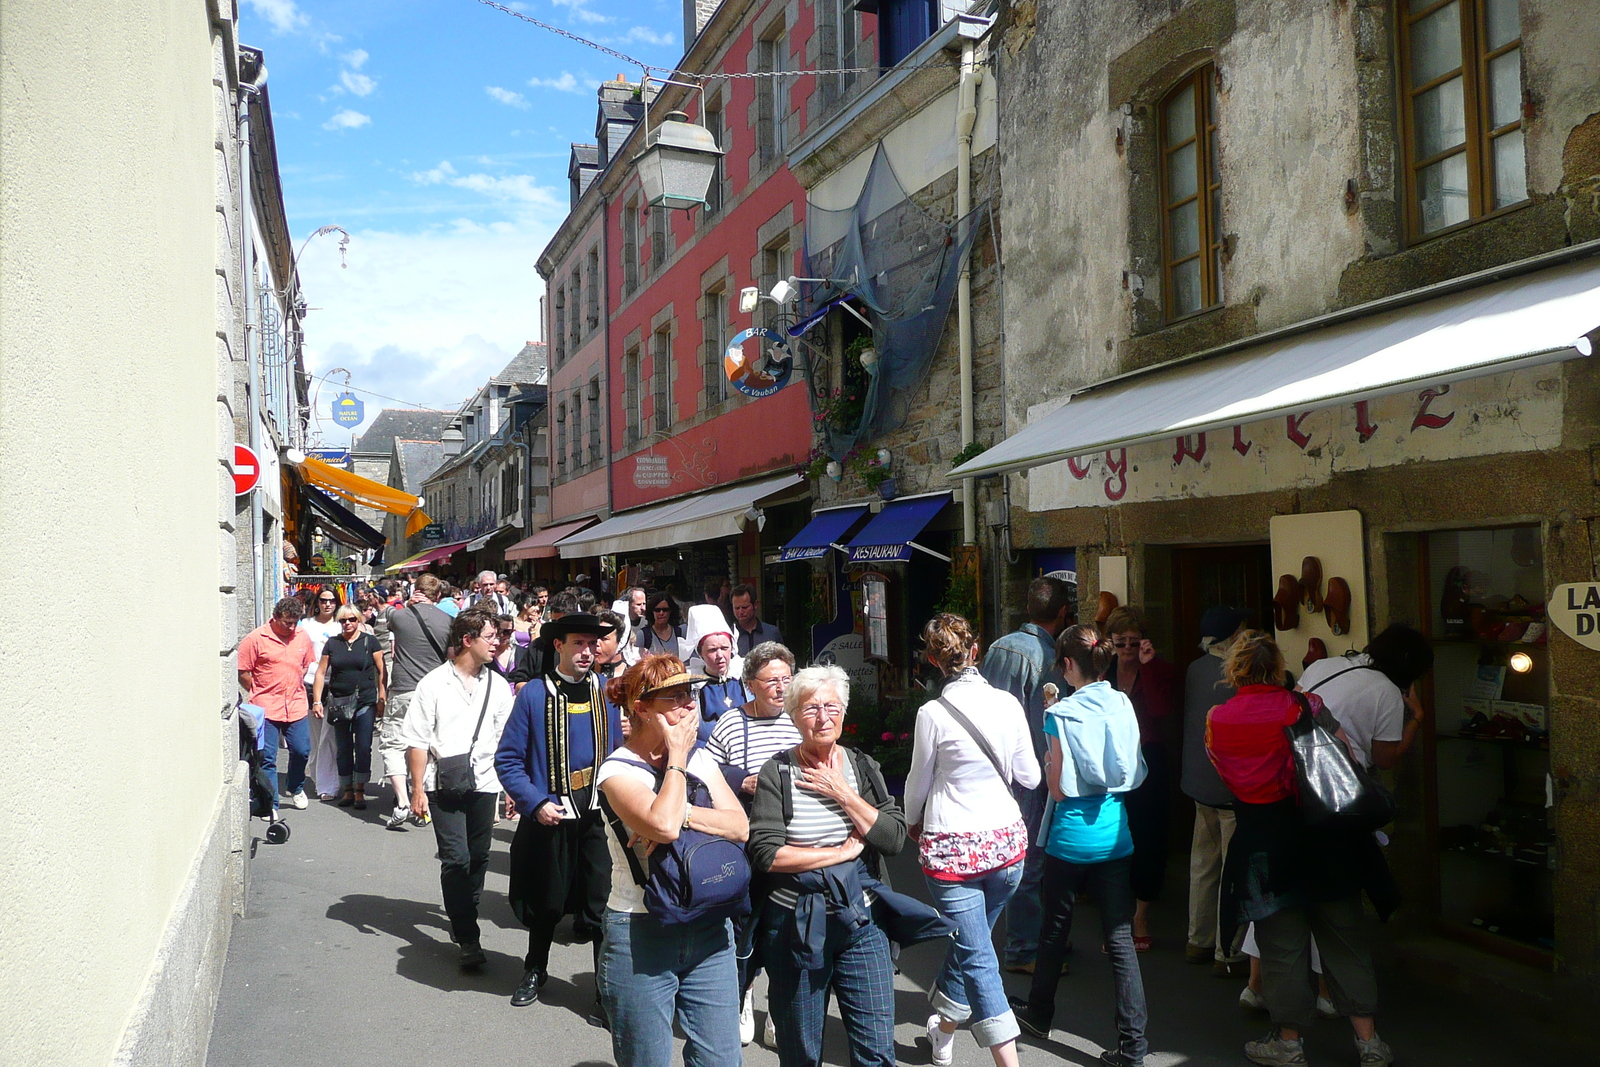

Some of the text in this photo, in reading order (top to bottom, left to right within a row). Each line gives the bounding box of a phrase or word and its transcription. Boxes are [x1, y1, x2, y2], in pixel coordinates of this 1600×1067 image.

[745, 328, 768, 338] BAR
[740, 385, 778, 396] Le Vauban
[853, 545, 904, 559] RESTAURANT
[1567, 586, 1600, 610] LA
